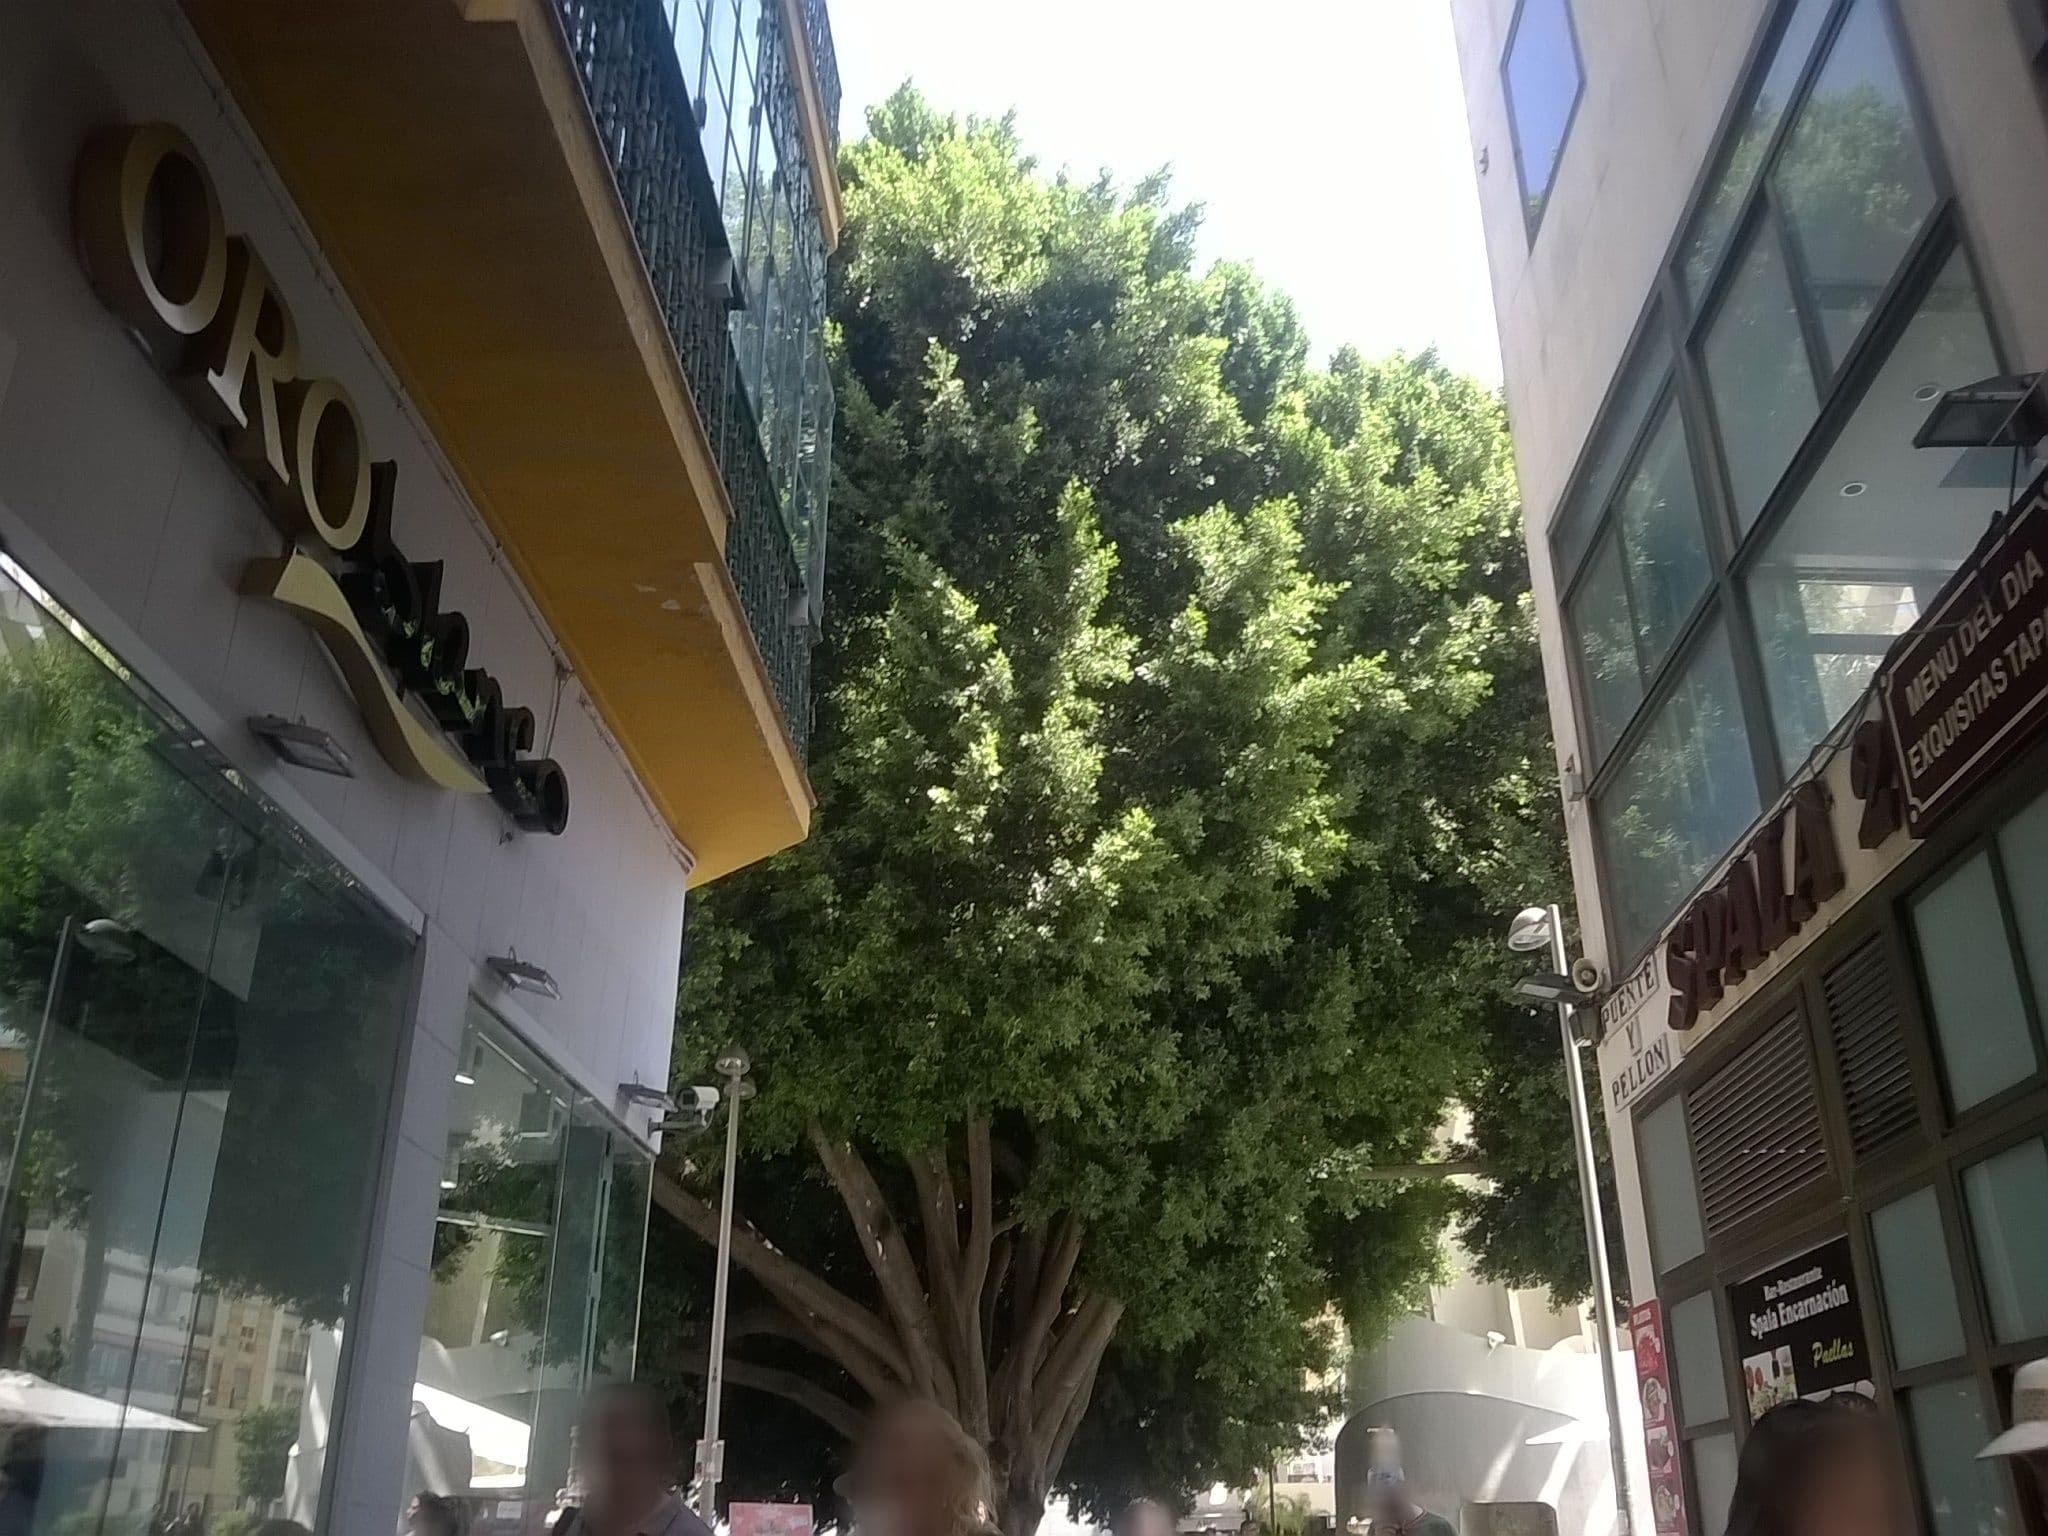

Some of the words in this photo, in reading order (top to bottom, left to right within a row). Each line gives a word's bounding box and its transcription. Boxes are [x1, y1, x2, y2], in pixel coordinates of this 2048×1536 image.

[118, 121, 371, 550] ORO
[1904, 637, 1959, 716] MENU
[1958, 597, 2003, 657] DEL
[2001, 550, 2045, 612] DIA
[1907, 657, 2008, 780] EXQUISITAS
[1601, 960, 1655, 1036] PUENTE
[1626, 1020, 1635, 1050] Y
[1611, 1037, 1666, 1106] PELLON
[1749, 1308, 1779, 1340] Spala
[1777, 1278, 1849, 1327] Encarnación
[1811, 1338, 1854, 1368] Paellas
